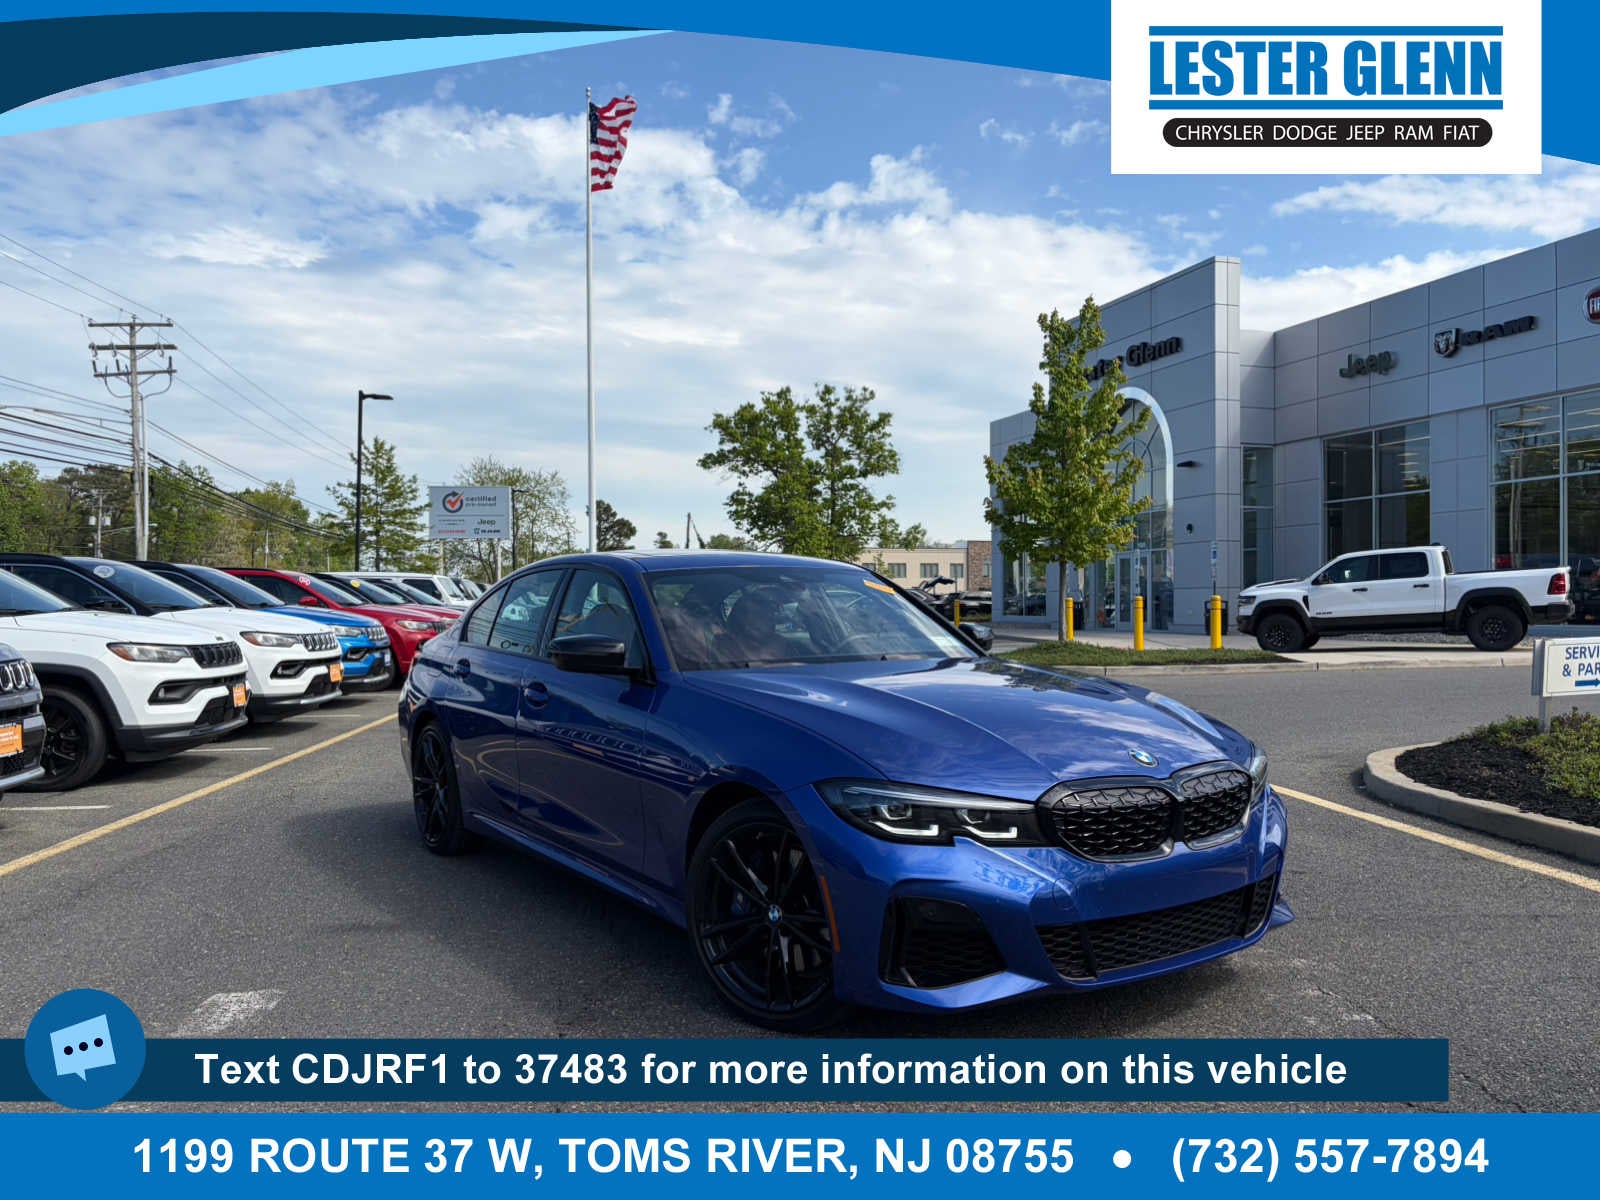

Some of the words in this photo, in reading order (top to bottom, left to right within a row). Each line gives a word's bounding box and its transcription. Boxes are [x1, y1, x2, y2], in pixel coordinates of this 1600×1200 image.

[1126, 336, 1184, 367] Glenn
[1339, 351, 1396, 378] Jeep
[477, 518, 496, 526] Jeep
[1565, 645, 1600, 660] SERVI
[1562, 663, 1571, 677] &
